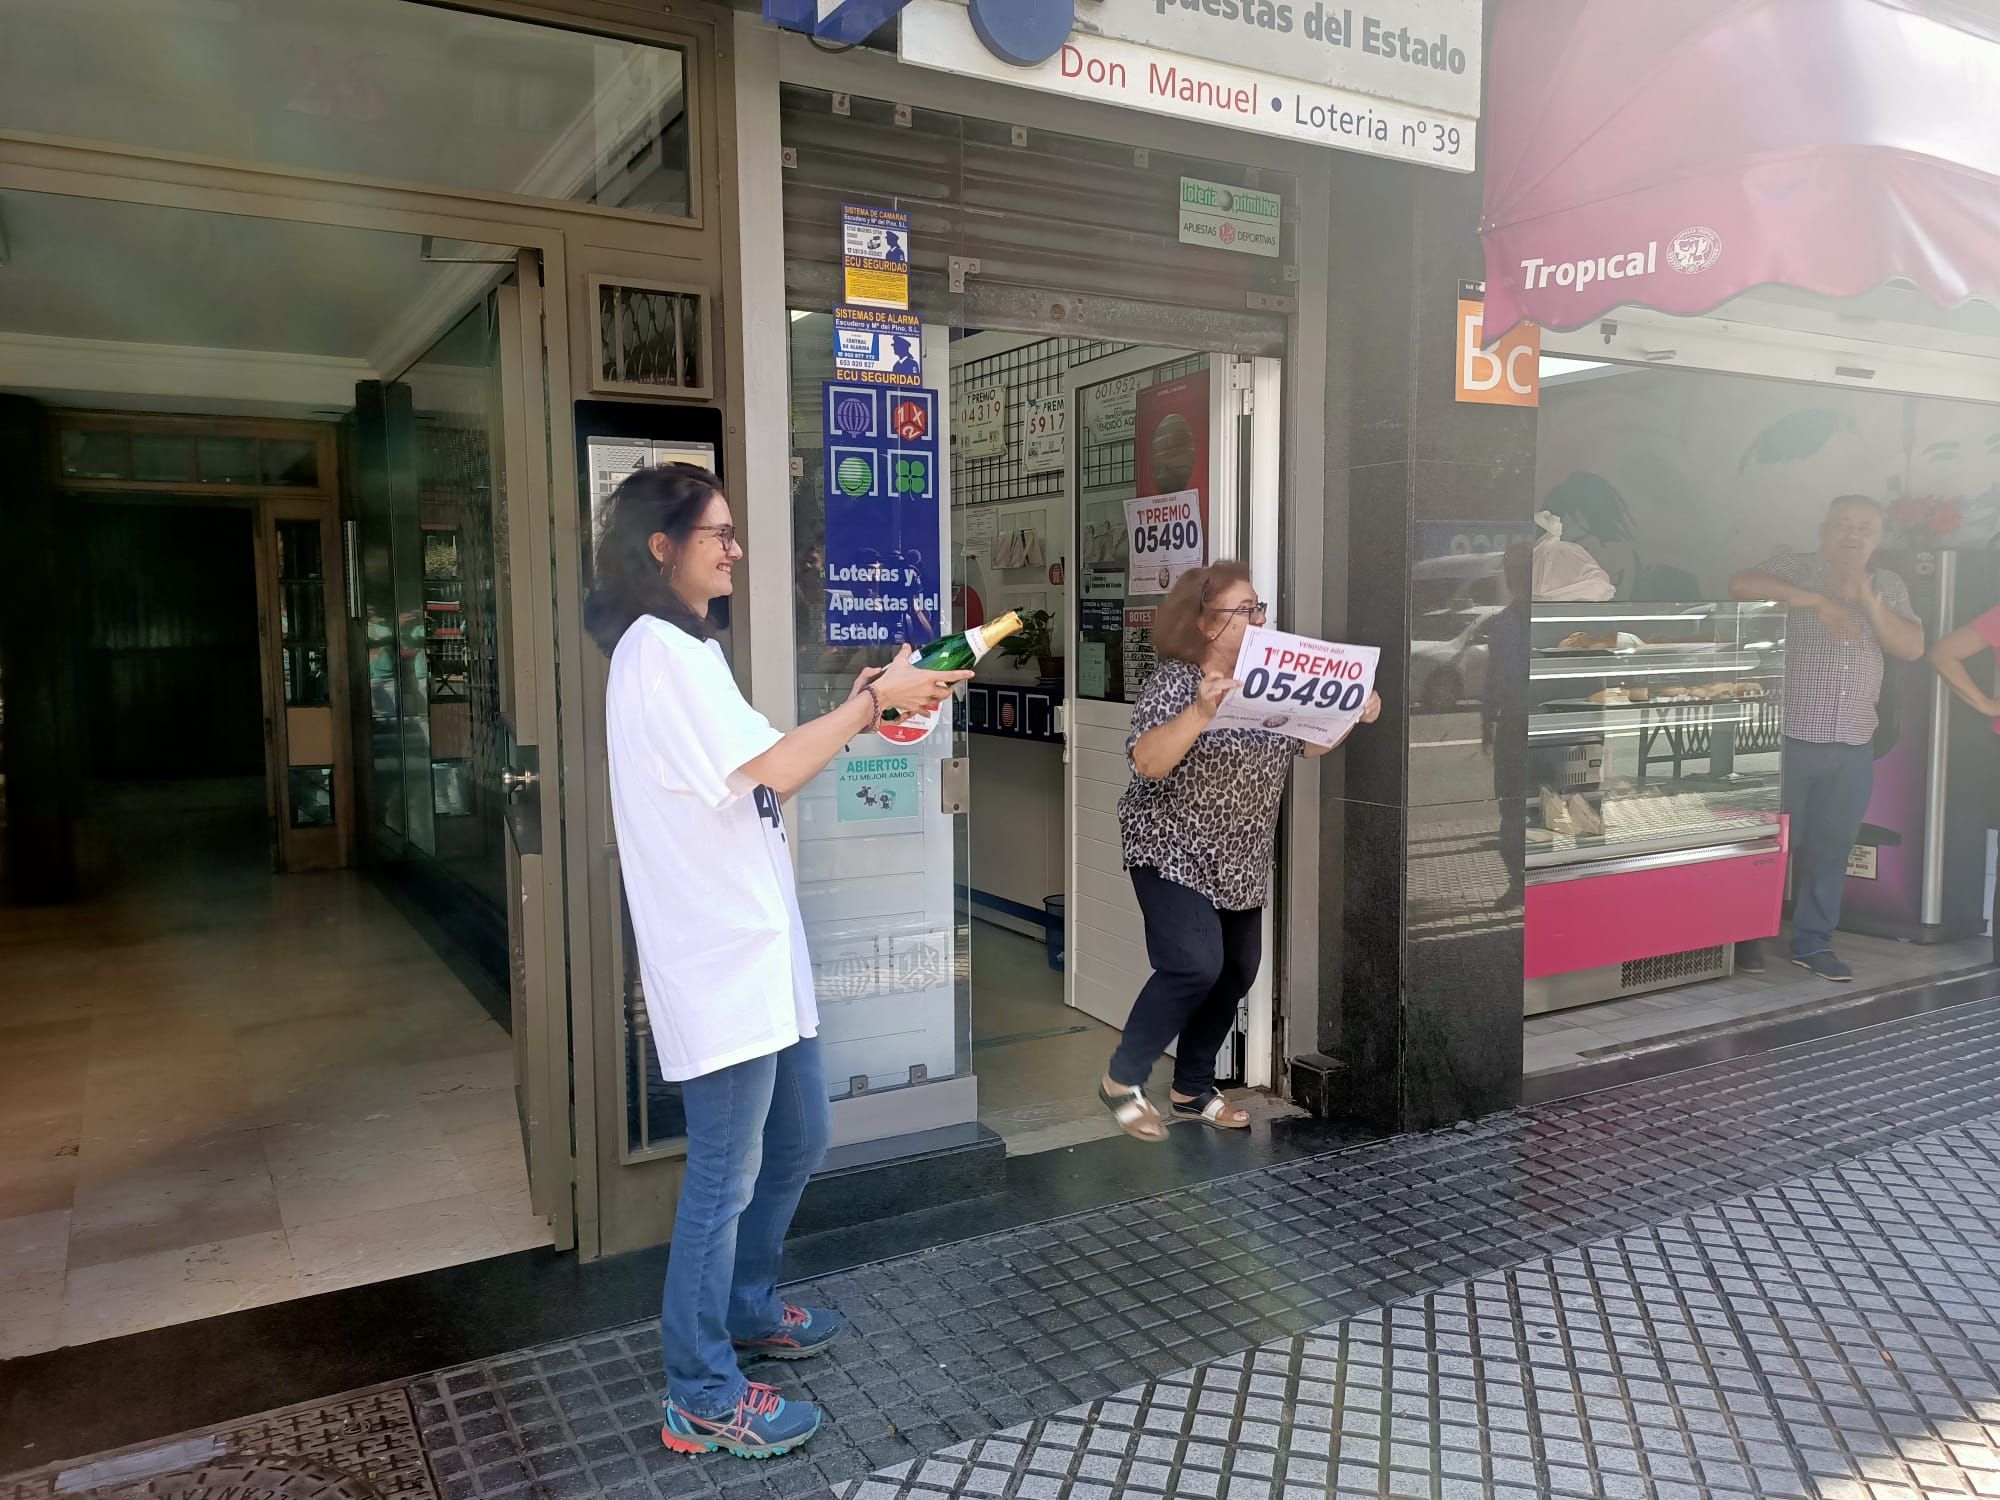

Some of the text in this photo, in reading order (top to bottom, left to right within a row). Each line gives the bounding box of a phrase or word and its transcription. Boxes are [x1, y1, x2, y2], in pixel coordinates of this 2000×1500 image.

[1303, 1, 1352, 48] del
[1362, 16, 1465, 75] Estado
[1061, 44, 1126, 89] Don
[1149, 62, 1257, 115] Manuel
[1432, 123, 1461, 155] 39
[844, 206, 869, 217] SISTEMA
[1183, 222, 1276, 246] APUESTAS DEPORTIVAS
[845, 256, 908, 273] ECU SEGURIDAD
[1519, 241, 1658, 292] Tropical
[835, 308, 920, 326] SISTEMAS DE ALARMA
[835, 319, 865, 328] Escudero
[836, 369, 921, 386] ECU SEGURIDAD
[1029, 412, 1065, 435] 5917
[1146, 503, 1191, 525] PREMIO
[1134, 519, 1199, 554] 05490
[904, 568, 914, 587] y
[829, 592, 939, 616] Apuestas del
[1129, 611, 1152, 622] BOTES
[830, 621, 889, 641] Estado
[1277, 650, 1363, 681] PREMIO
[1242, 667, 1365, 712] 05490
[846, 757, 908, 774] ABIERTOS
[846, 774, 858, 782] TU
[859, 772, 888, 781] MEJOR
[888, 771, 916, 780] AMIGO
